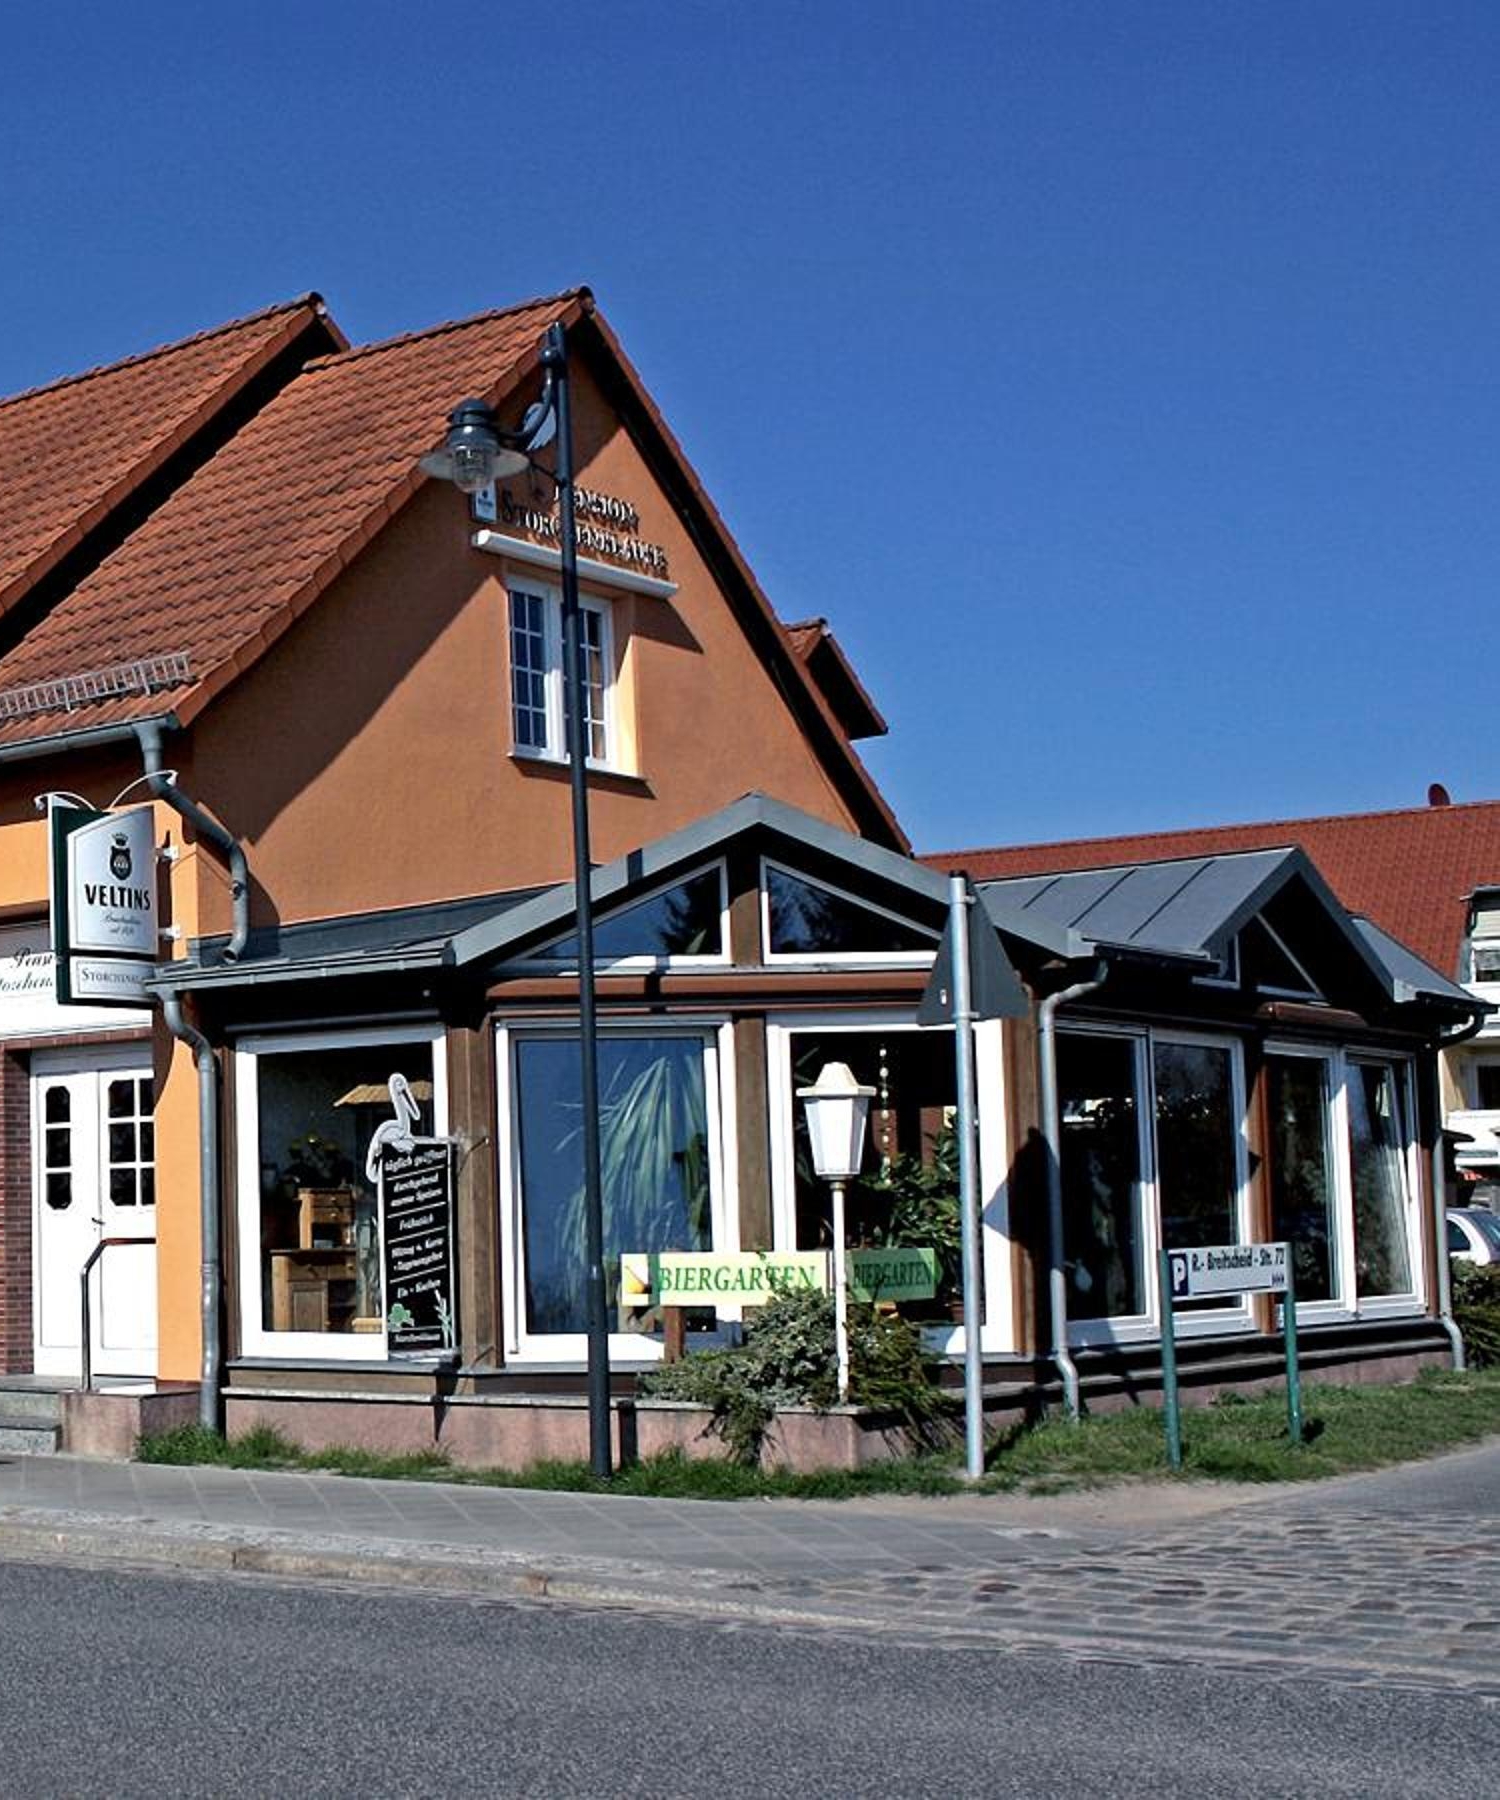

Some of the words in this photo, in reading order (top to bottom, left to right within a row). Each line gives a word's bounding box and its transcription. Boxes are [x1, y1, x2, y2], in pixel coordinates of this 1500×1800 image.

[502, 489, 668, 568] STORCENKLAUSE
[85, 884, 151, 911] VELTINS
[1207, 1249, 1253, 1271] Breitscheid
[658, 1266, 816, 1292] BIERGARTEN
[852, 1261, 933, 1289] BIERGARTEN
